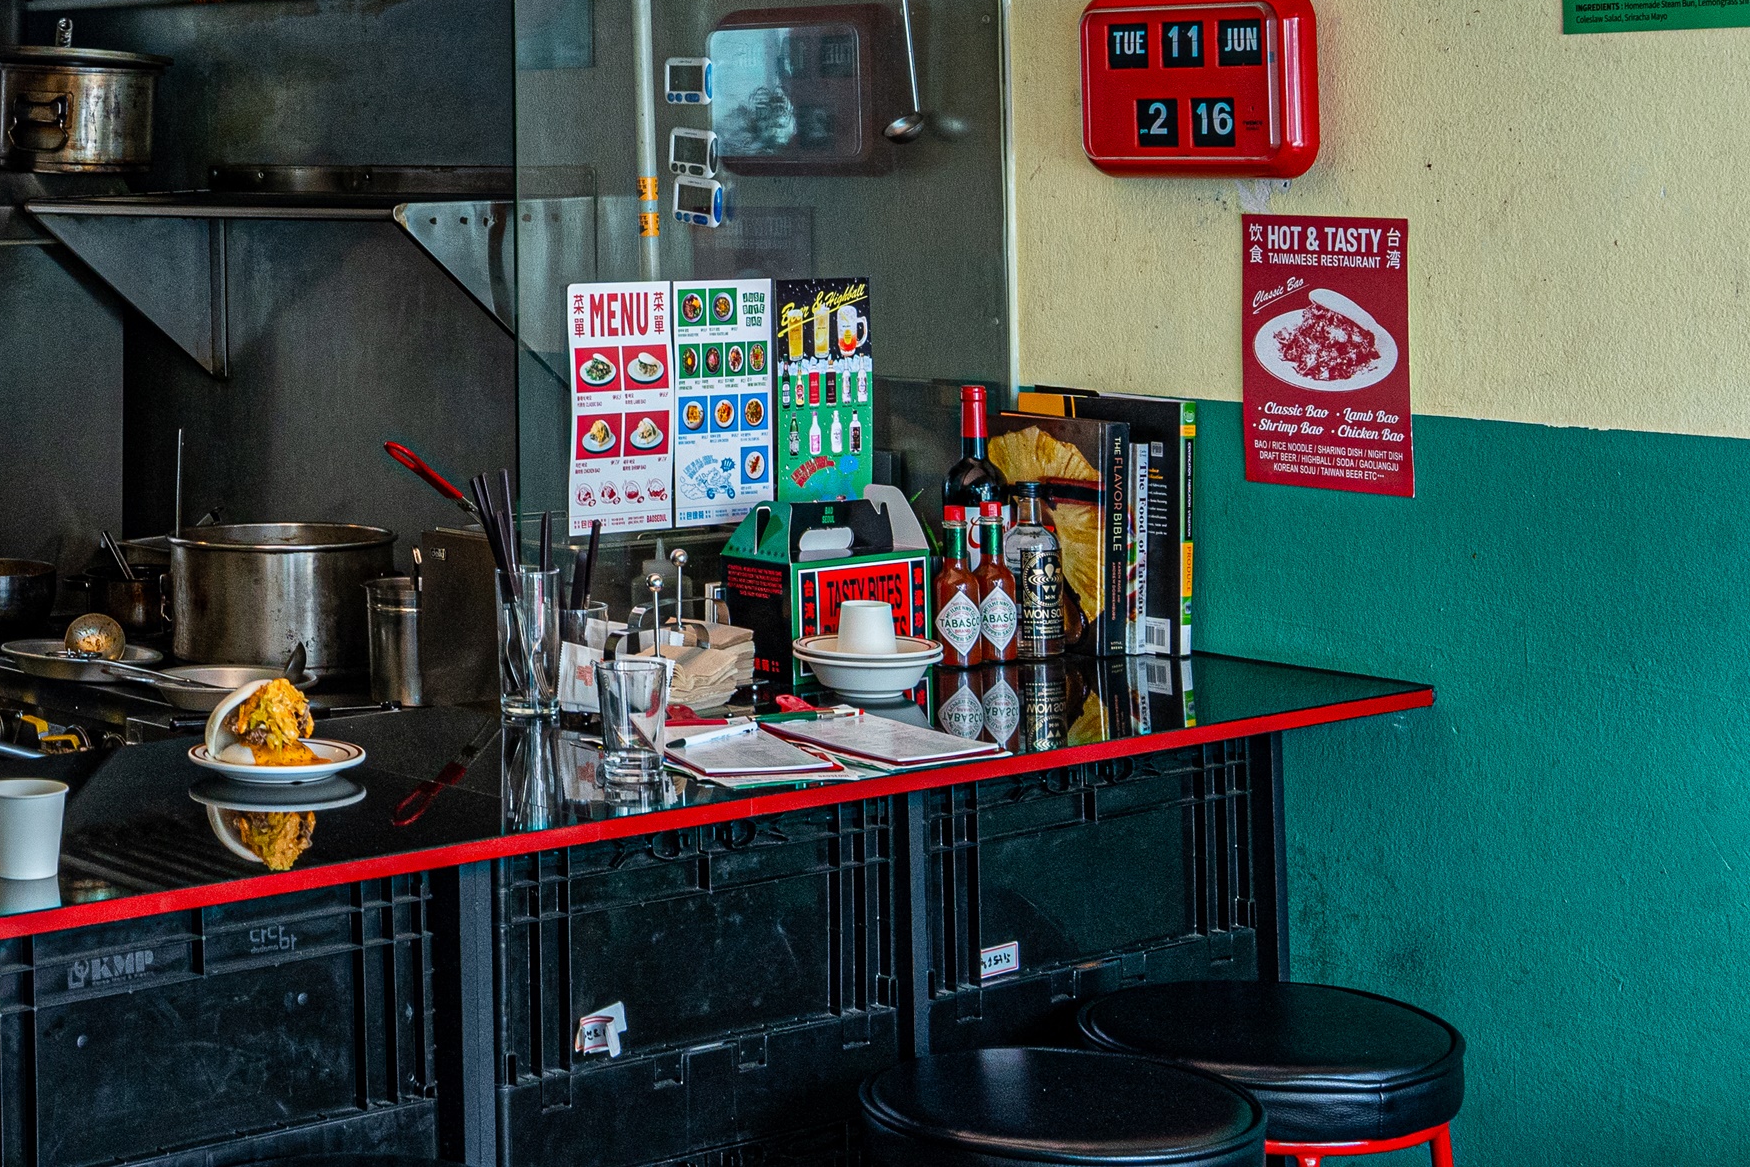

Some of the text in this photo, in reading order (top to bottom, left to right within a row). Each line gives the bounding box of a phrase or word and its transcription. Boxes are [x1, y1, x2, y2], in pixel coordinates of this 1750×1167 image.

[1576, 3, 1620, 12] INGREDIENTS
[1625, 0, 1660, 10] Homemade
[1662, 0, 1681, 8] Steam
[1682, 0, 1697, 8] Bun,
[1576, 12, 1667, 24] Coleslaw Salad, Sriracha Mayo
[1113, 25, 1257, 57] TUE 11 JUN
[1149, 102, 1168, 135] 2
[1196, 102, 1233, 135] 16
[1249, 223, 1263, 264] 饮食
[1267, 226, 1382, 253] HOT & TASTY
[1386, 228, 1401, 269] 台湾
[1268, 253, 1381, 268] TAIWANESE RESTAURANT
[743, 292, 765, 302] JUST
[1253, 276, 1304, 307] Classic Bao
[590, 292, 648, 337] MENU
[743, 304, 764, 314] BITE
[781, 302, 809, 326] Beer
[825, 284, 865, 305] Highball
[746, 317, 762, 327] BAO
[1264, 402, 1399, 424] Classic Bao Lamb Bao
[1259, 418, 1405, 442] Shrimp Bao Chicken Bao
[1255, 440, 1403, 461] BAO RICE NOODLE SHARING DISH NIGHT DISH
[1259, 450, 1399, 471] DRAFT BEER HIGHBALL SODA GAOLIANGJU
[1114, 457, 1123, 510] FLAVOR
[1274, 463, 1363, 479] KOREAN SOJU TAIWAN BEER
[1139, 497, 1147, 534] Food
[1113, 513, 1122, 551] BIBLE
[1139, 540, 1146, 554] of
[827, 578, 864, 616] TASTY
[868, 573, 902, 610] BITES
[1024, 609, 1049, 618] WON
[92, 950, 154, 981] KMP
